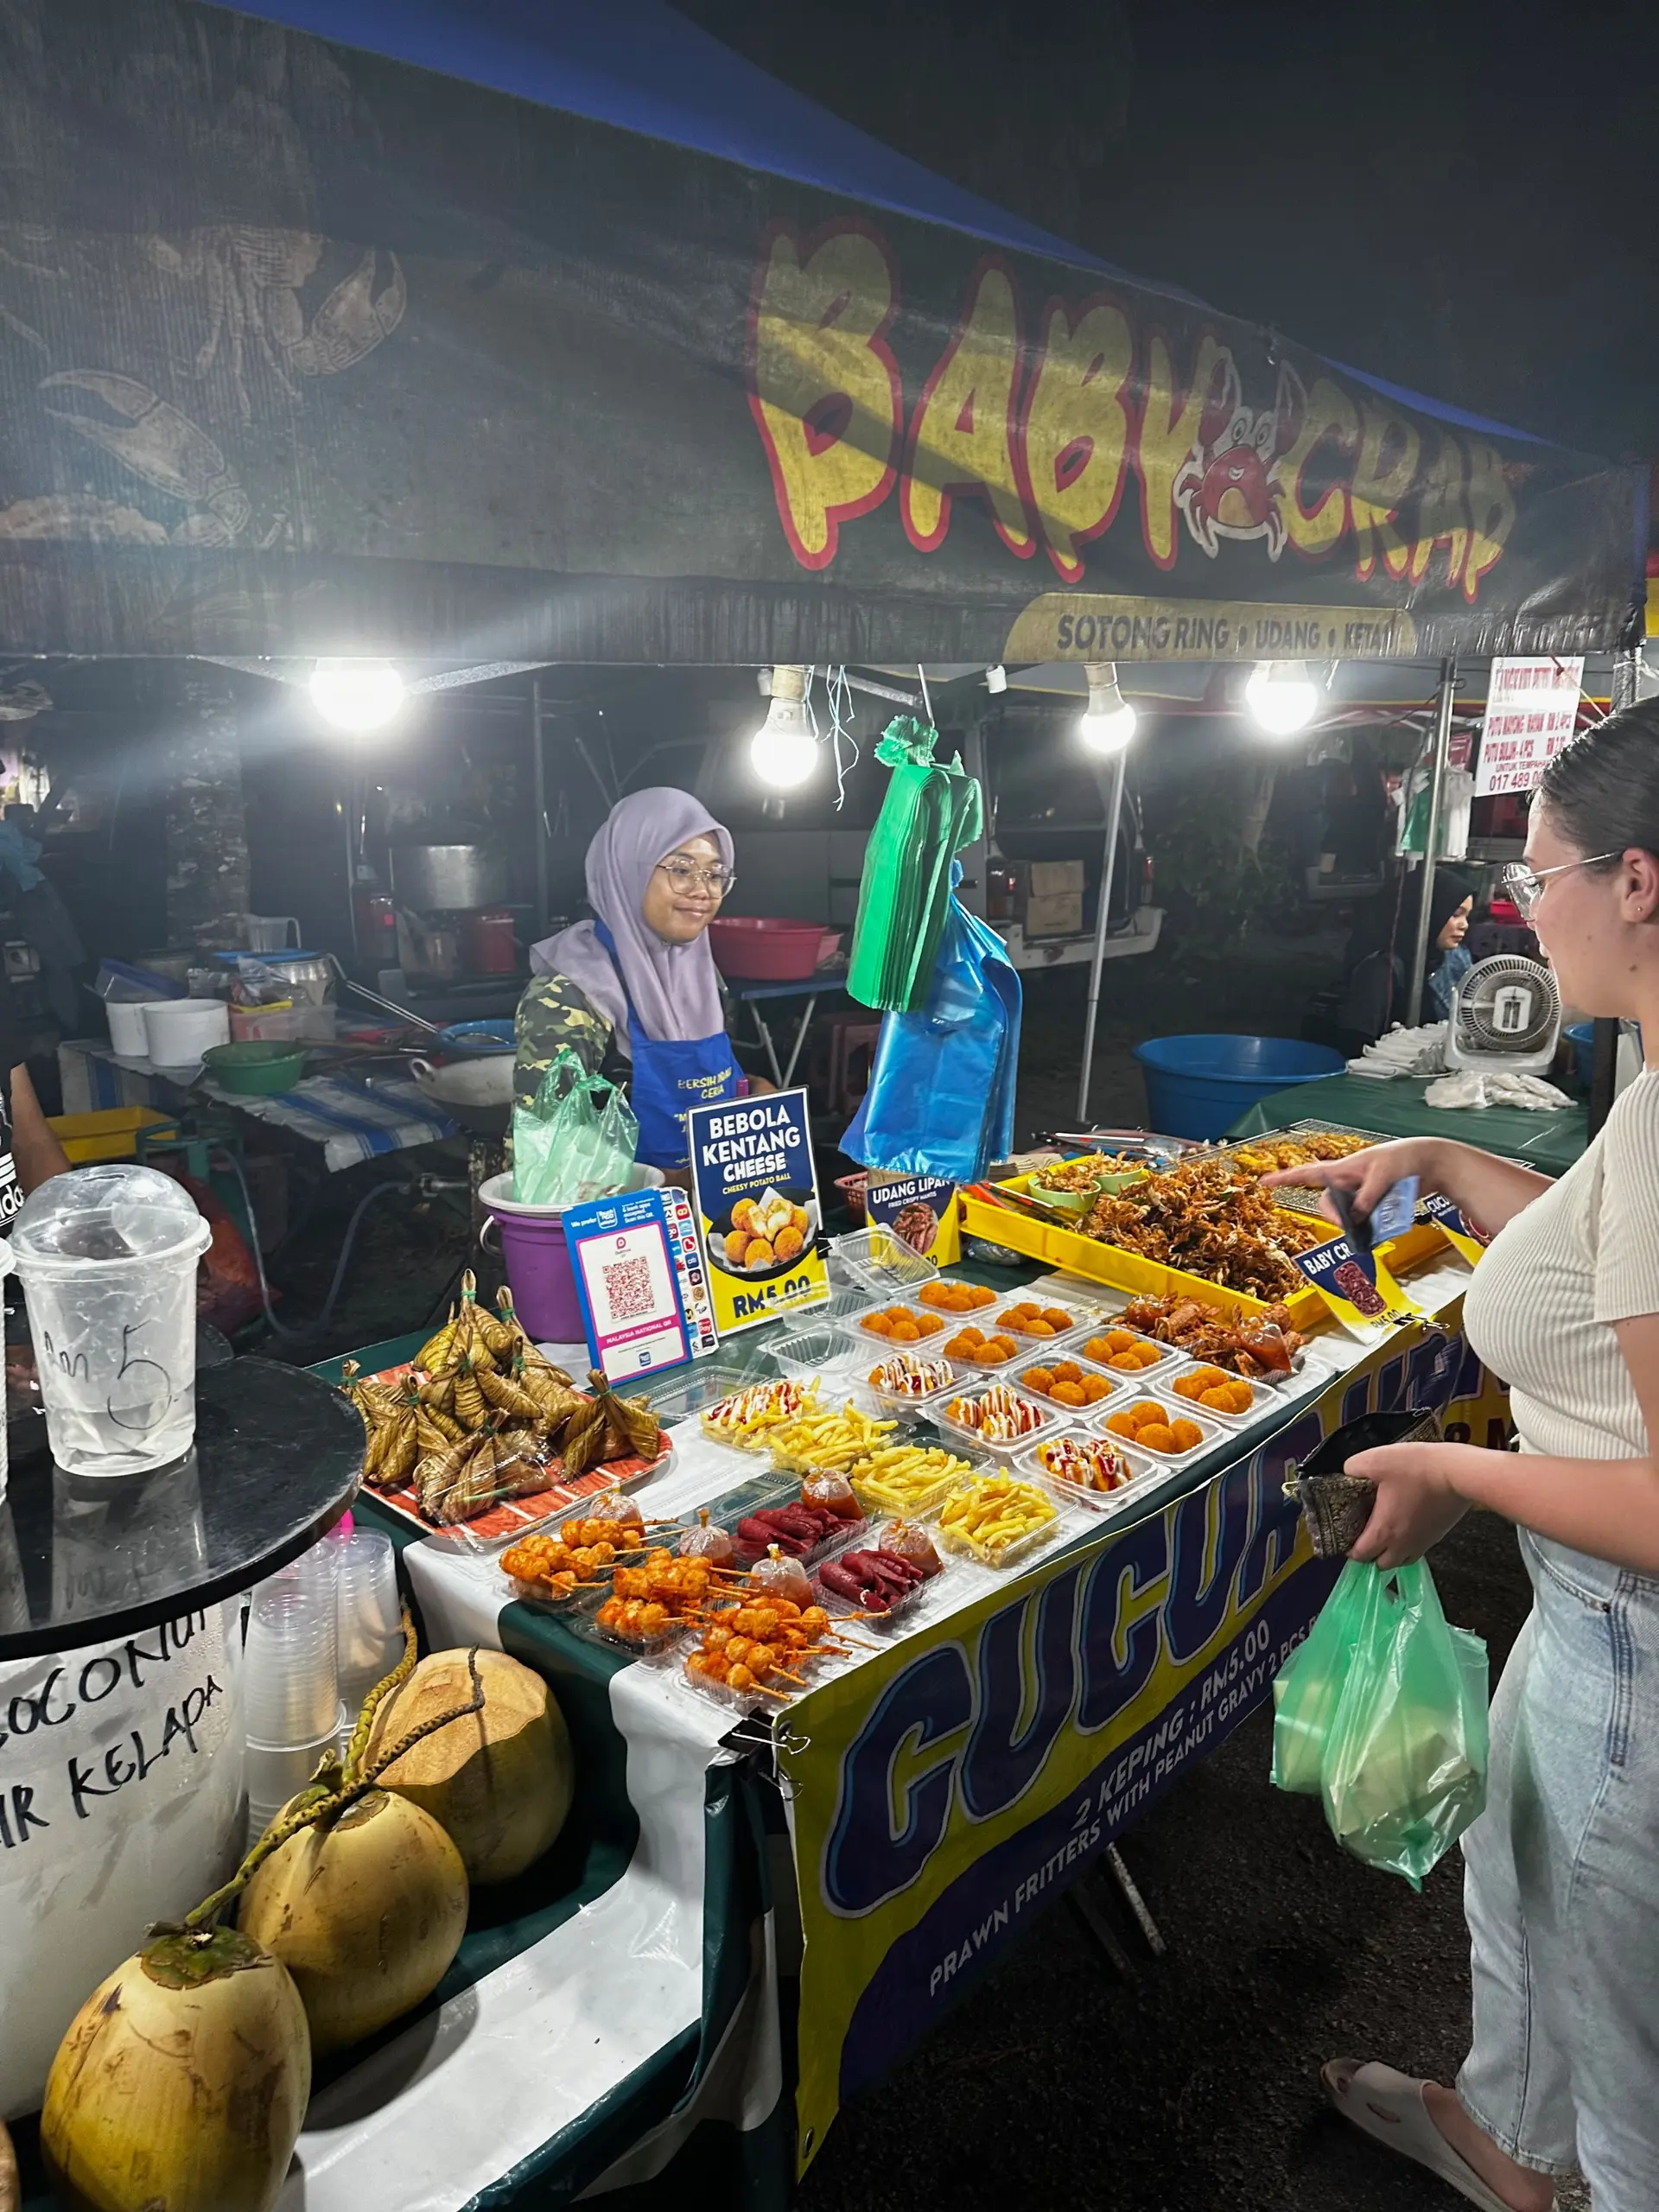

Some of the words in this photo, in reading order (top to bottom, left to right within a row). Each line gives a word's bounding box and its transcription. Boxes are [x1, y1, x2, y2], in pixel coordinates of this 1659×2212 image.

[747, 216, 1227, 585] BABY
[1275, 376, 1518, 605] CRAB
[1057, 614, 1169, 650] SOTONG
[1173, 619, 1229, 650] RING
[1255, 620, 1321, 649] UDANG
[1489, 774, 1510, 791] 017
[1511, 772, 1530, 788] 489
[709, 1104, 791, 1140] BEBOLA
[702, 1126, 801, 1166] KENTANG
[722, 1182, 748, 1195] CHEESY
[749, 1176, 775, 1188] POTATO
[776, 1173, 791, 1182] BALL
[723, 1152, 786, 1182] CHEESE
[872, 1181, 916, 1204] UDANG
[1427, 1195, 1452, 1213] CUCU
[1303, 1249, 1336, 1274] BABY
[1333, 1243, 1356, 1261] CR
[607, 1332, 634, 1344] MALAYSIA
[635, 1323, 663, 1334] NATIONAL
[107, 1319, 173, 1431] 5
[1071, 1797, 1091, 1831] 2
[1097, 1707, 1185, 1811] KEPING
[1200, 1619, 1269, 1712] RM5.00
[0, 1784, 50, 1849] IR
[68, 1675, 224, 1820] KELAPA
[930, 1900, 1008, 1998] PRAWN
[1014, 1817, 1102, 1914] FRITTERS
[1106, 1770, 1150, 1827] WITH
[1154, 1711, 1214, 1784] PEANUT
[1218, 1659, 1267, 1722] GRAVY
[1268, 1652, 1277, 1676] 2
